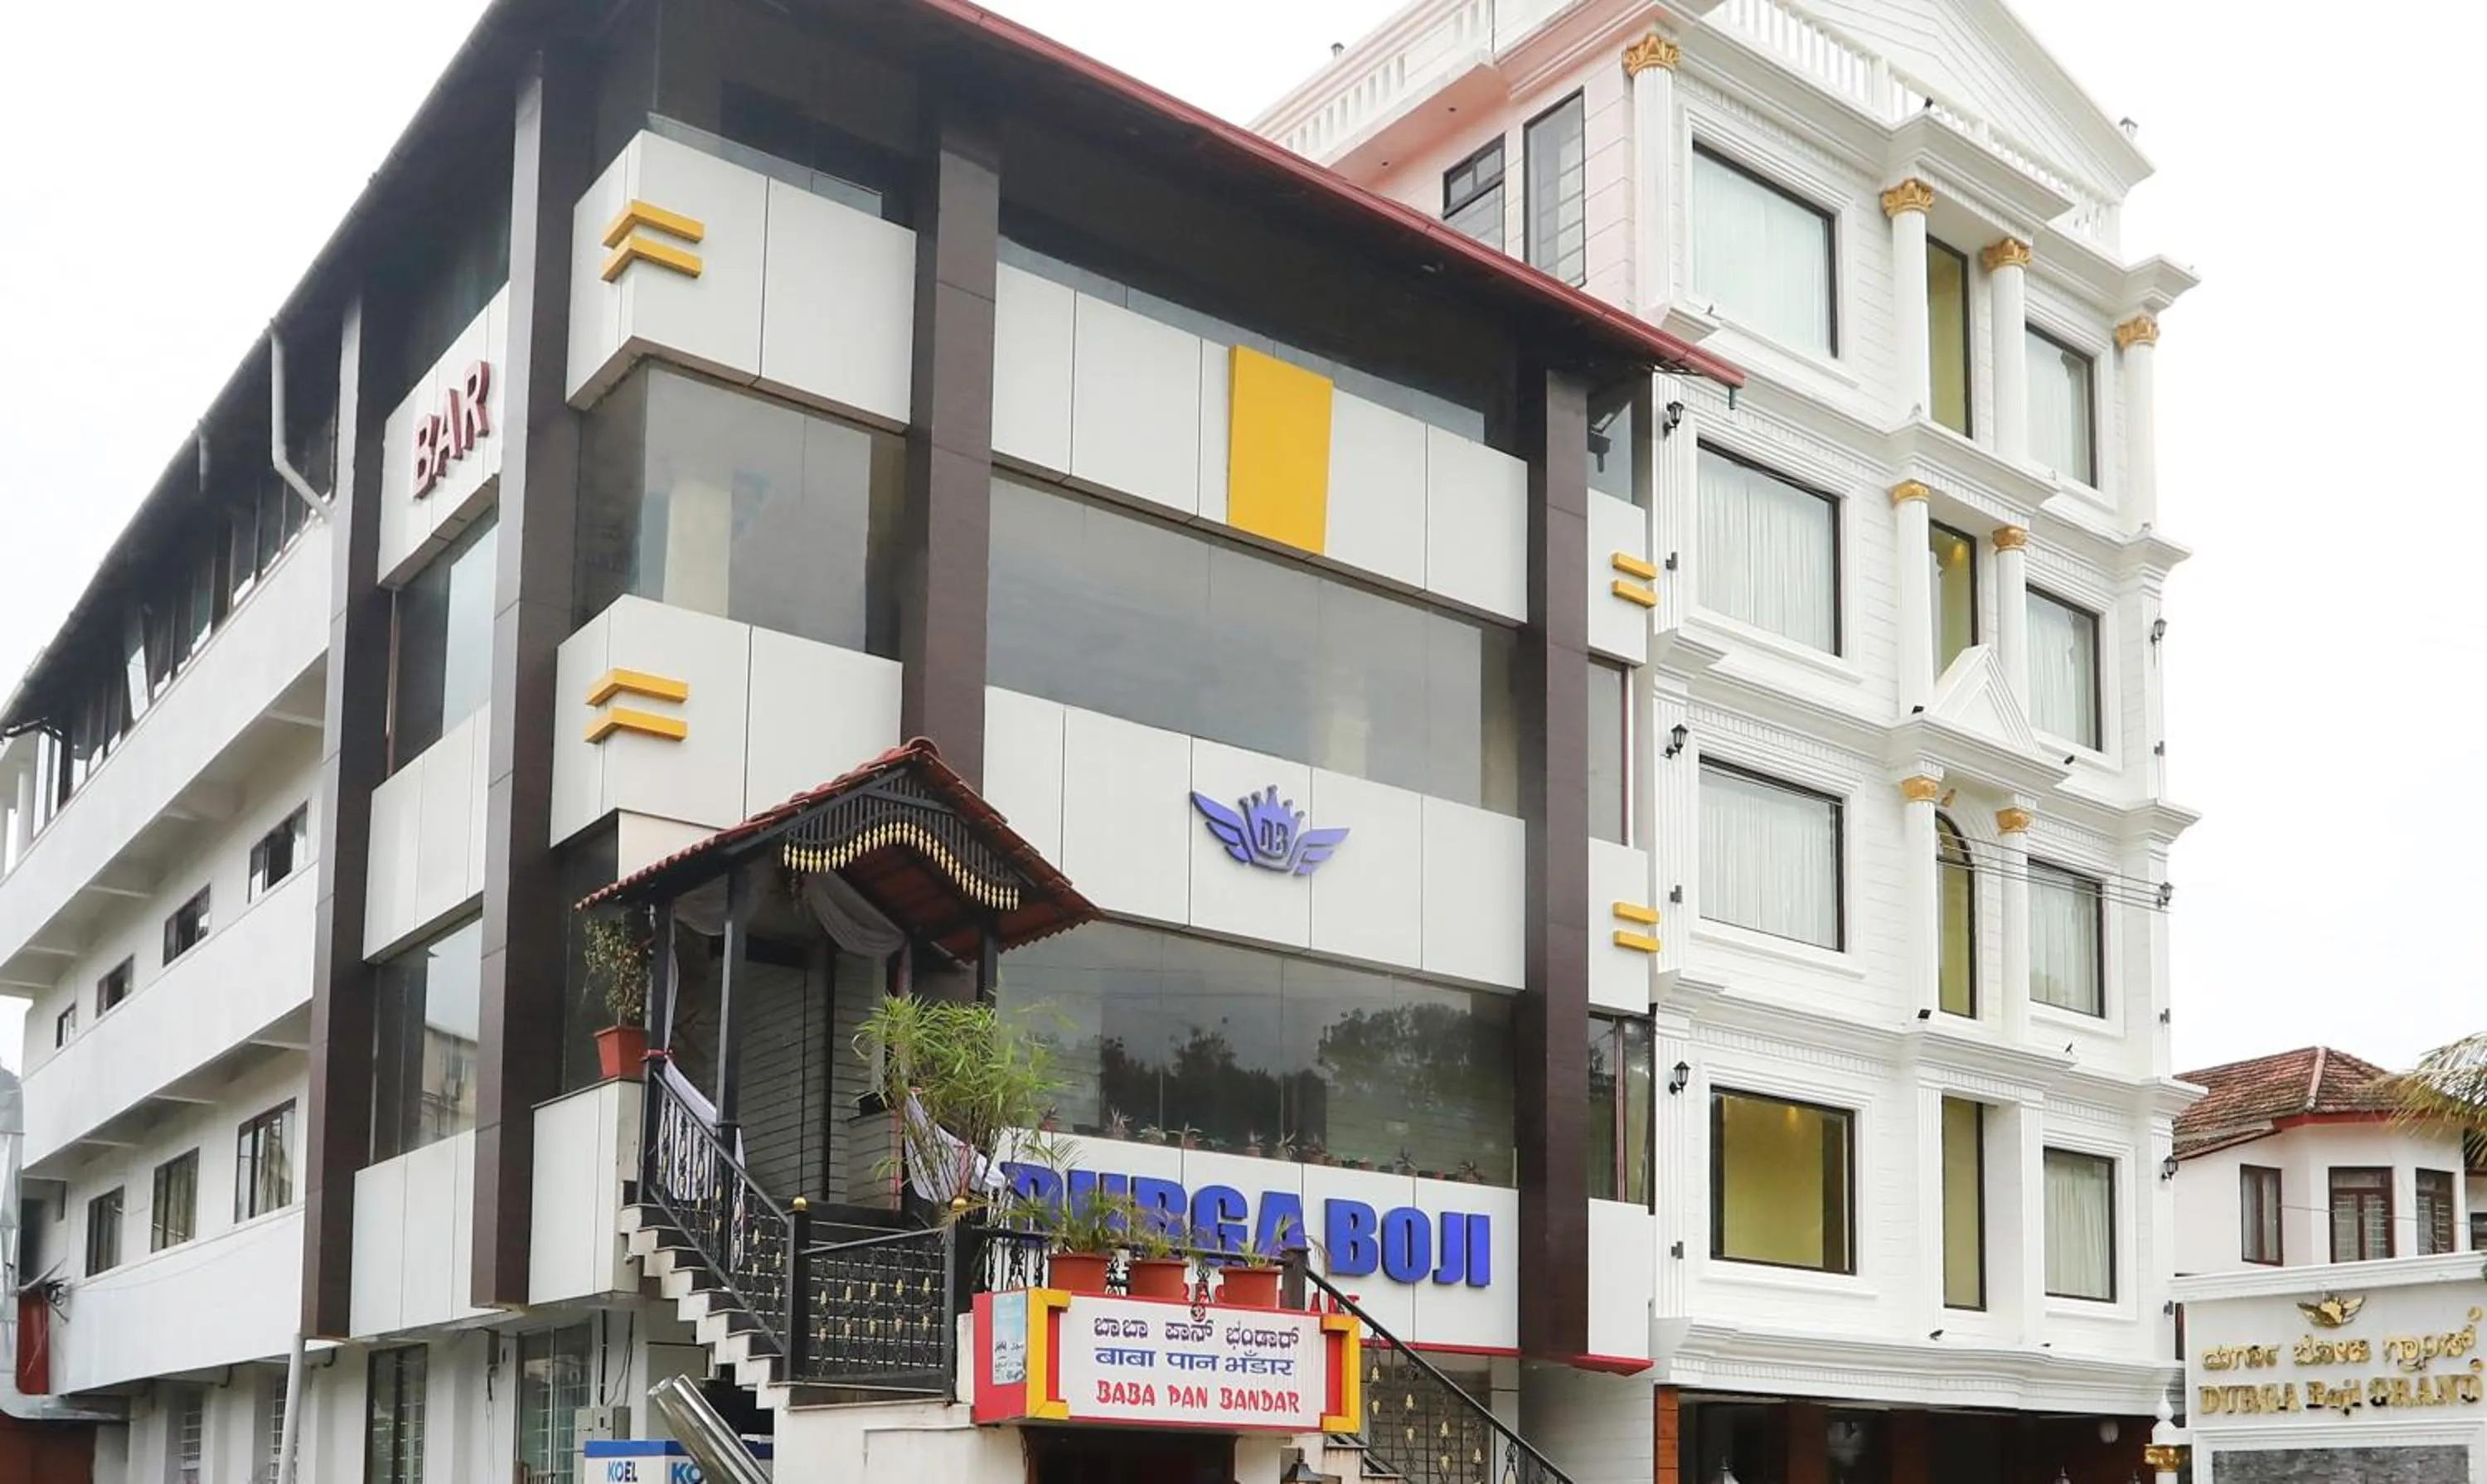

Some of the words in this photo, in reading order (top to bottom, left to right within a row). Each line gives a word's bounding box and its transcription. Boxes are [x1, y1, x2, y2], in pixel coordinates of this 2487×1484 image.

[413, 360, 492, 499] BAR
[1000, 1161, 1310, 1266] DURGA
[1324, 1197, 1491, 1288] BOJI
[1094, 1347, 1156, 1368] बाबा
[1166, 1352, 1219, 1372] पान
[1097, 1380, 1155, 1407] BABA
[1167, 1385, 1208, 1409] PAN
[1220, 1387, 1300, 1413] BANDAR
[2199, 1383, 2300, 1414] DURGA
[2367, 1374, 2484, 1408] GRAND
[607, 1460, 638, 1483] KOEL
